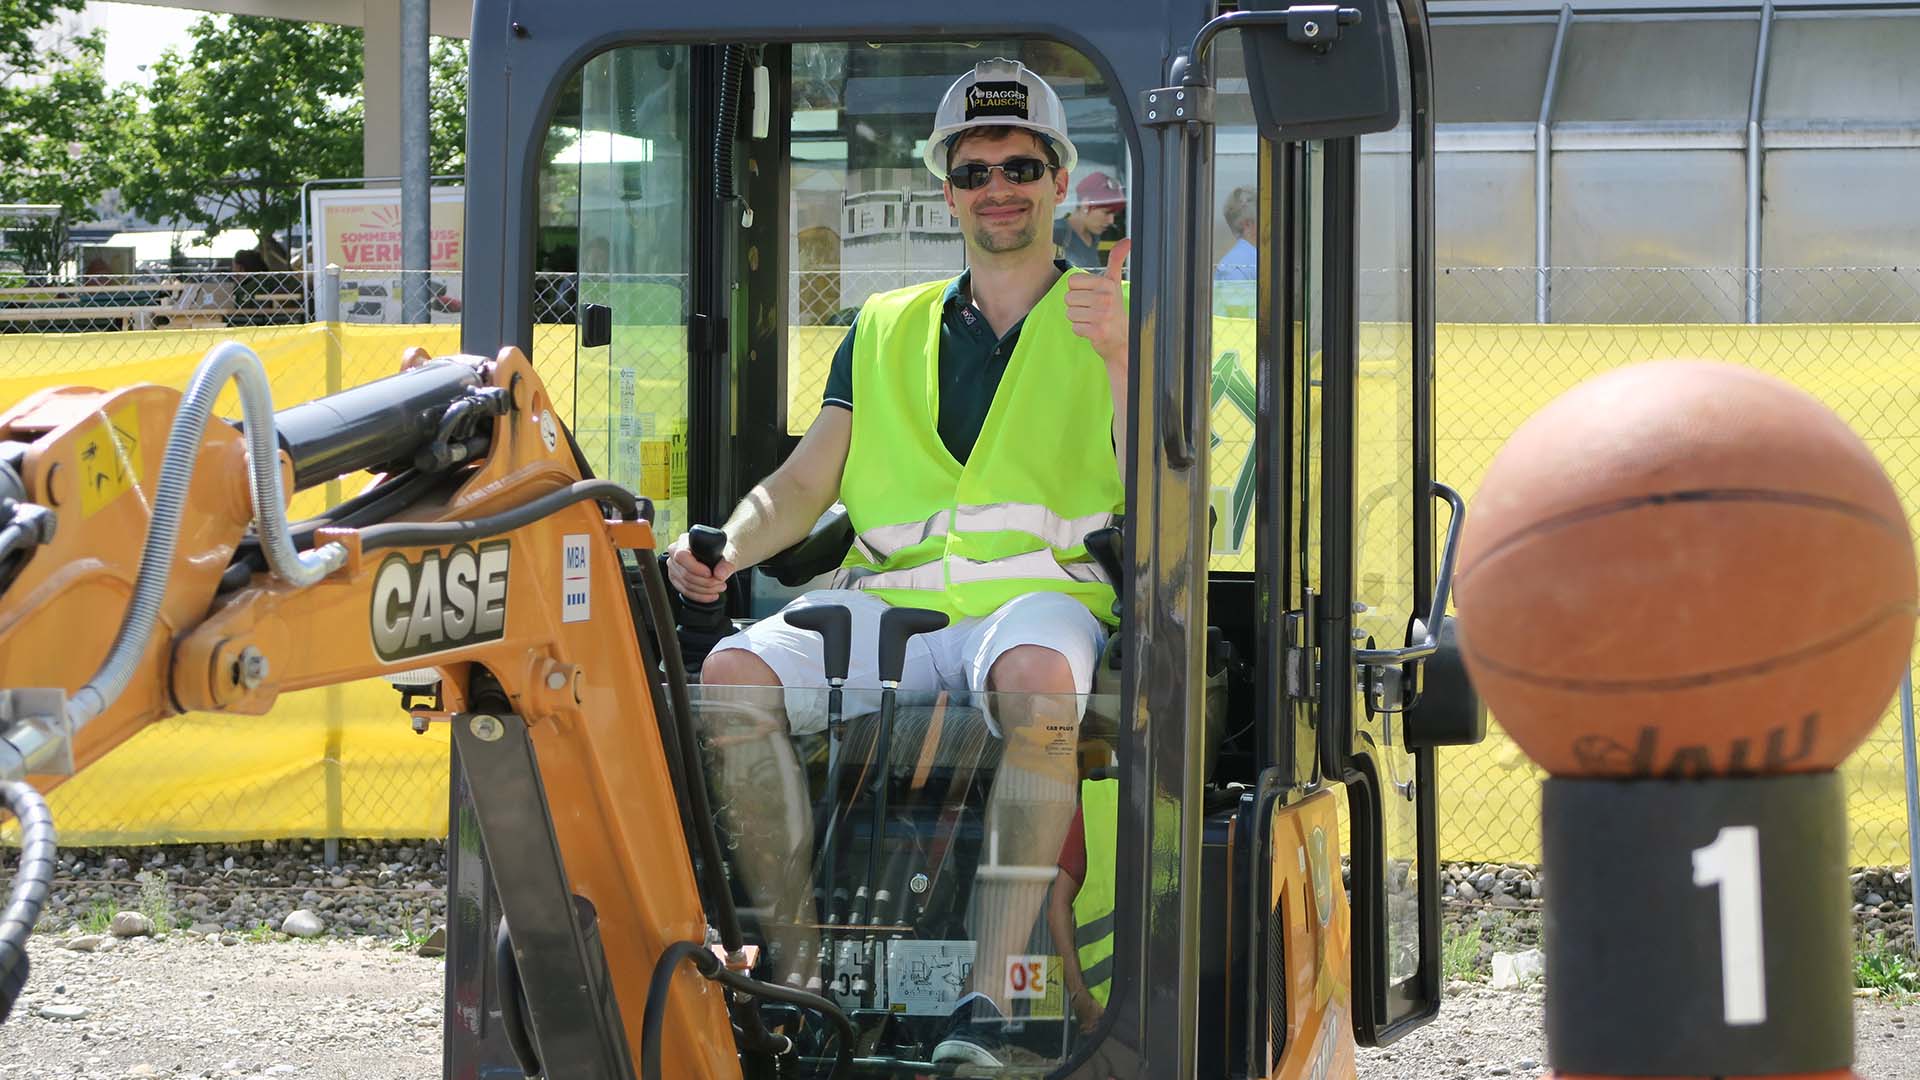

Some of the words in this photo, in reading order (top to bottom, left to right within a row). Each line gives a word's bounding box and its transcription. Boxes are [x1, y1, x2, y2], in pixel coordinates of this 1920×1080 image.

[372, 546, 509, 654] CASE
[566, 547, 587, 569] MBA
[1692, 825, 1767, 1026] 1
